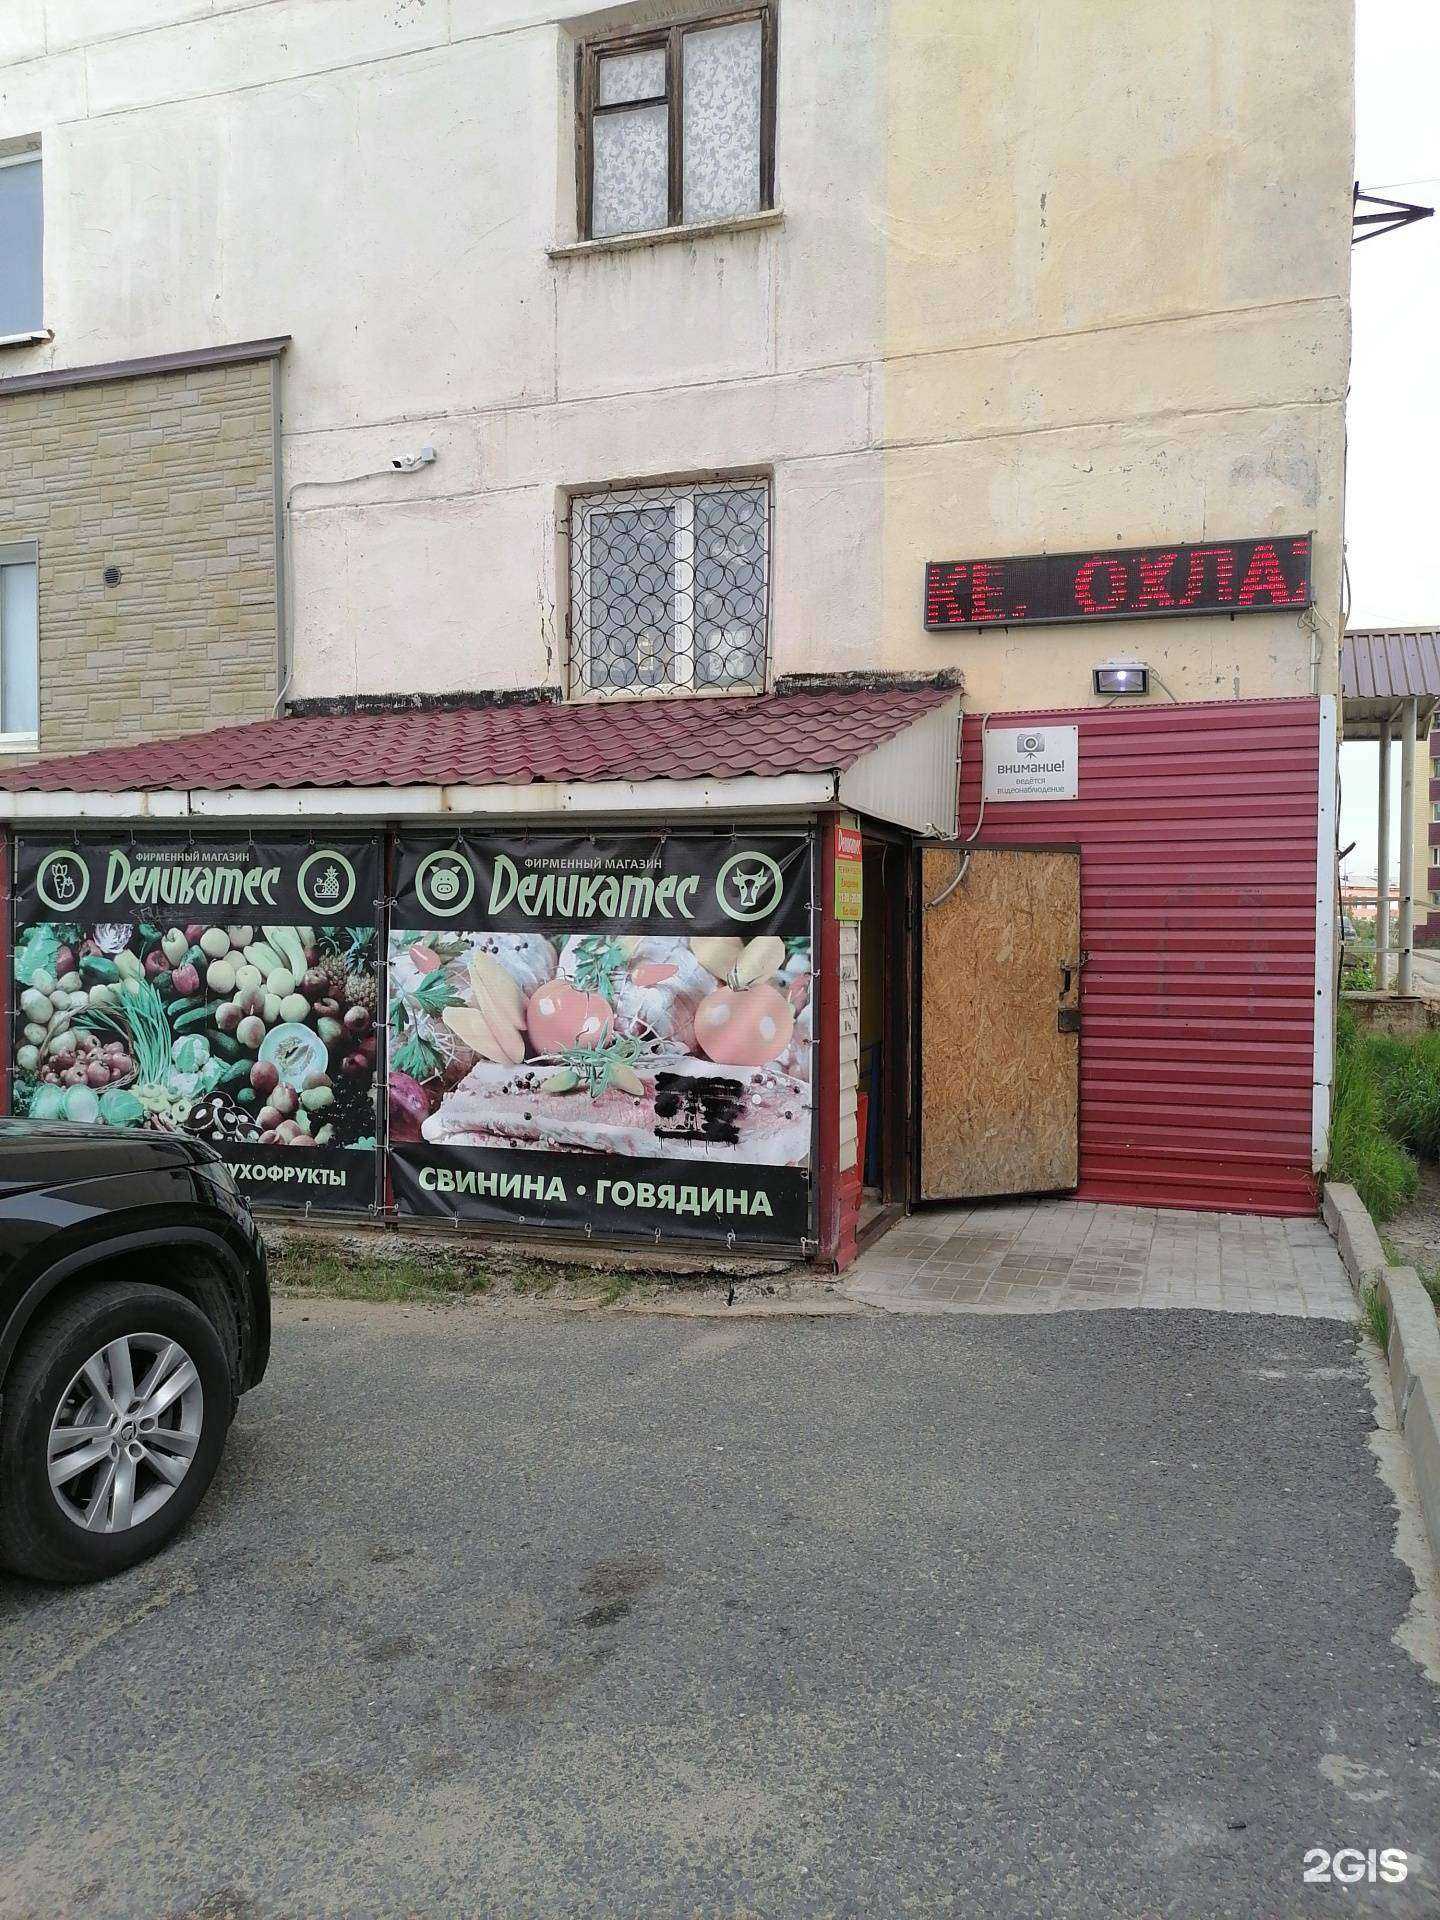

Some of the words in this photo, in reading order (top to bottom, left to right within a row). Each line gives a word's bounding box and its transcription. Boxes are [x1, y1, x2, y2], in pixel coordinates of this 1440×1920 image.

[997, 760, 1065, 775] внимание!
[997, 785, 1065, 795] видеонаблюдение
[135, 851, 200, 863] ФИРМЕННЫЙ
[202, 852, 250, 862] МАГАЗИН
[524, 857, 602, 869] ФИРМЕННЫЙ
[605, 858, 662, 869] МАГАЗИН
[103, 849, 281, 906] Деликатес
[488, 854, 700, 919] Деликатес
[224, 1162, 347, 1187] УХОФРУКТЫ
[418, 1166, 568, 1202] СВИНИНА
[597, 1179, 774, 1217] ГОВЯДИНА
